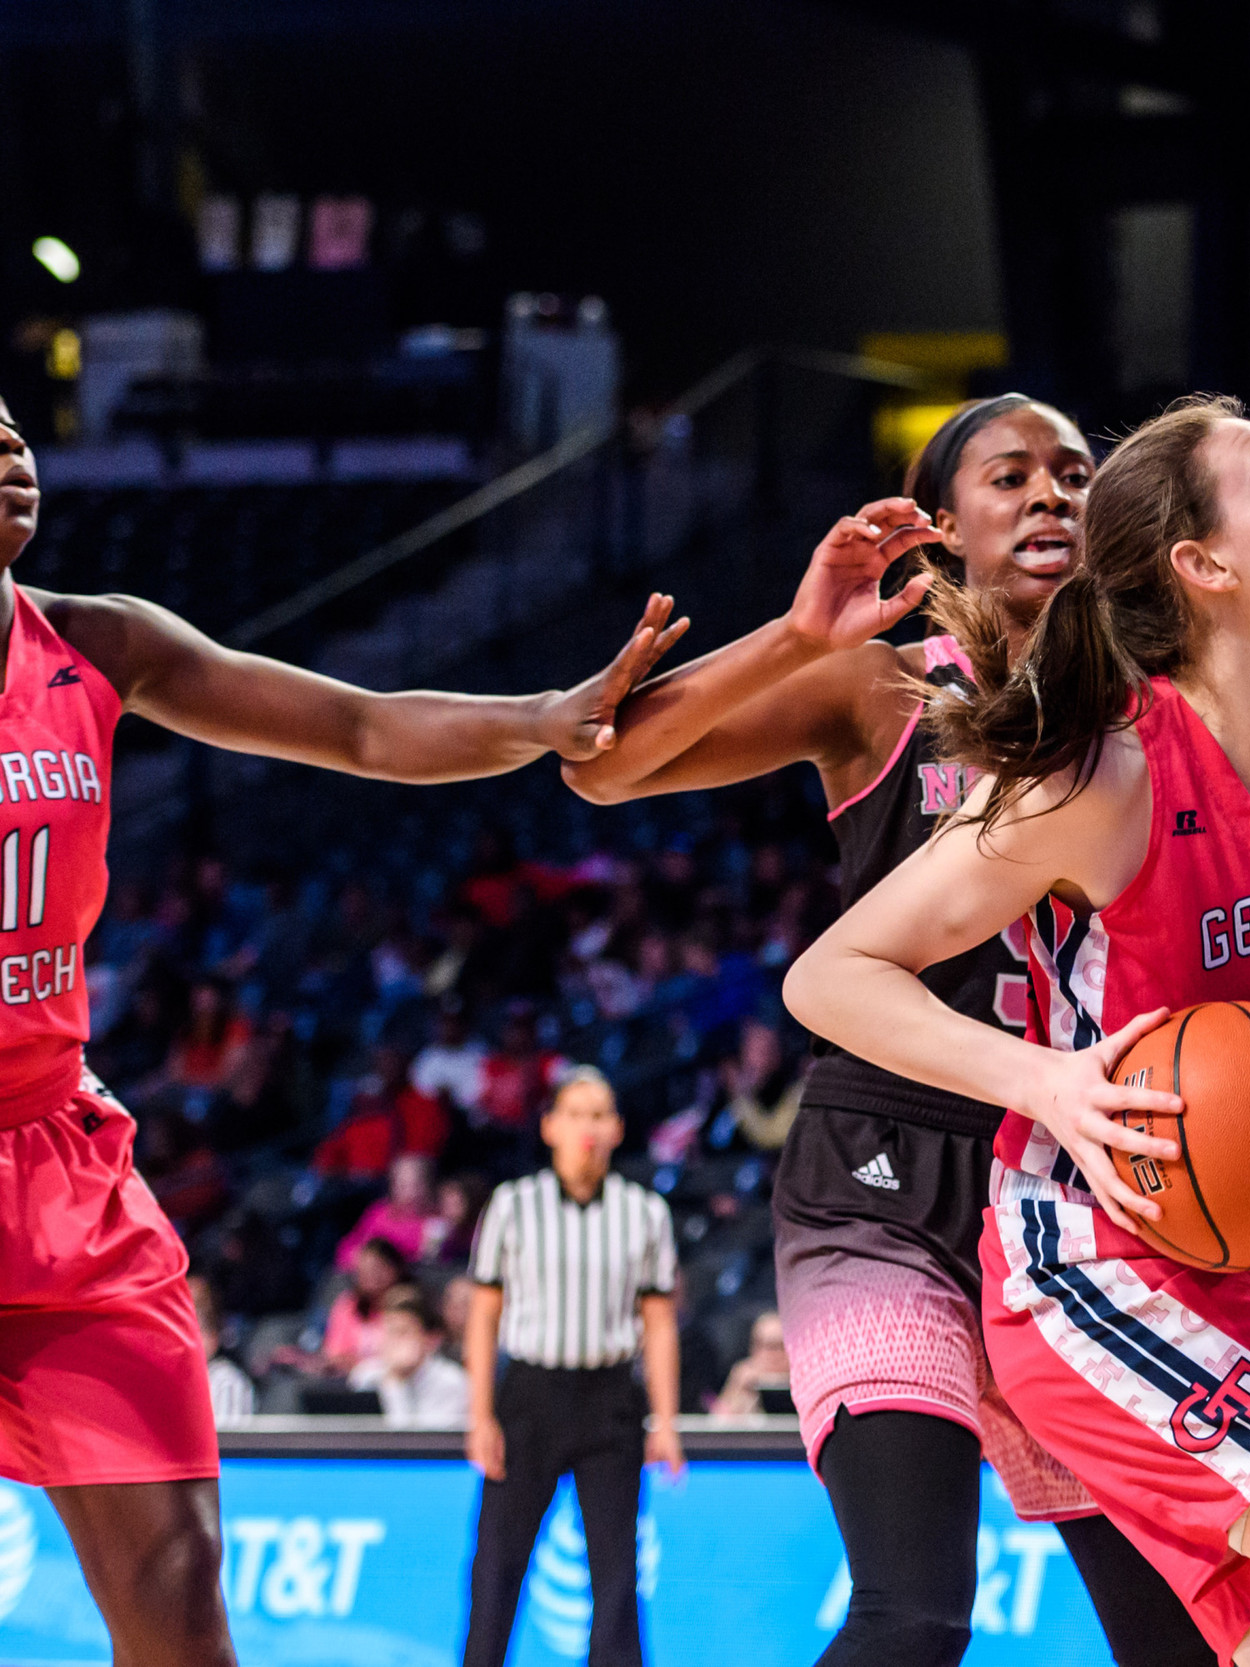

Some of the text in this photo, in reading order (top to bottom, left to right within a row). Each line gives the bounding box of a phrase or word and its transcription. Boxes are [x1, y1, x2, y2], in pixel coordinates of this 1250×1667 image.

[0, 749, 101, 804] RGIA
[0, 824, 50, 932] 11
[851, 1170, 900, 1191] adidas
[221, 1517, 387, 1618] T&T
